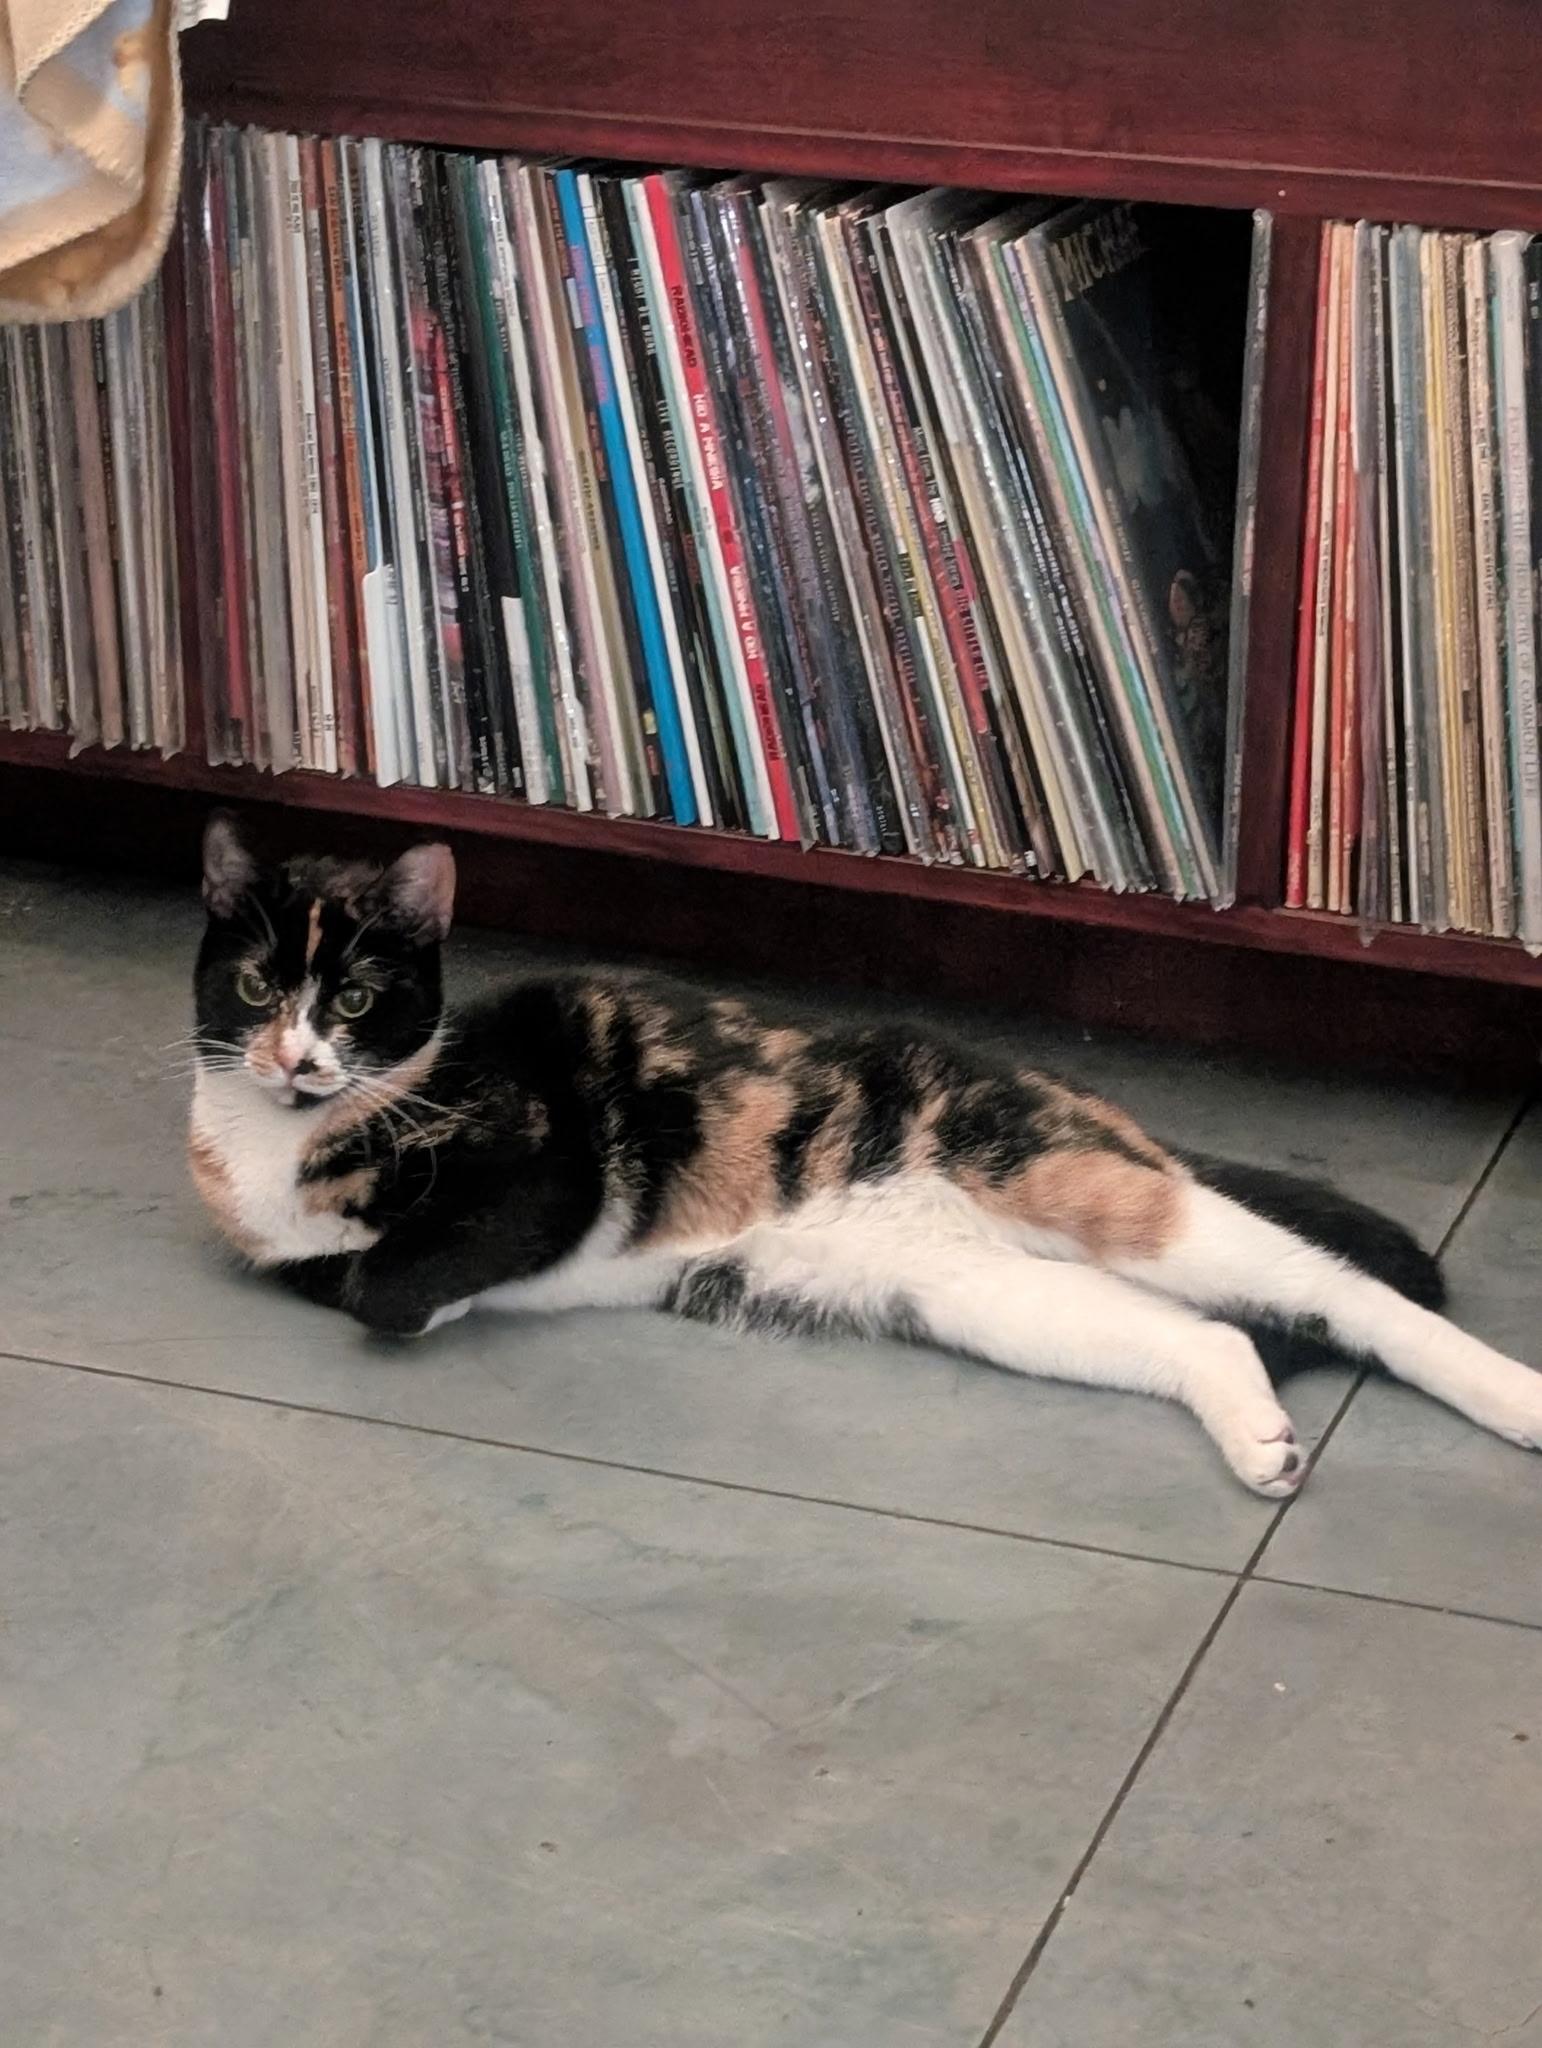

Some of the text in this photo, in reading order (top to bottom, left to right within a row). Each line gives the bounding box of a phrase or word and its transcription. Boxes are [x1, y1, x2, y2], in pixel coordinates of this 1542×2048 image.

[671, 284, 698, 369] RADIOHEAD
[692, 393, 708, 418] KID
[699, 422, 709, 433] A
[702, 436, 724, 490] MNESIA
[930, 498, 946, 523] HBO
[1519, 651, 1532, 670] OF
[1521, 679, 1537, 756] COMMON
[1524, 761, 1539, 798] LIFE
